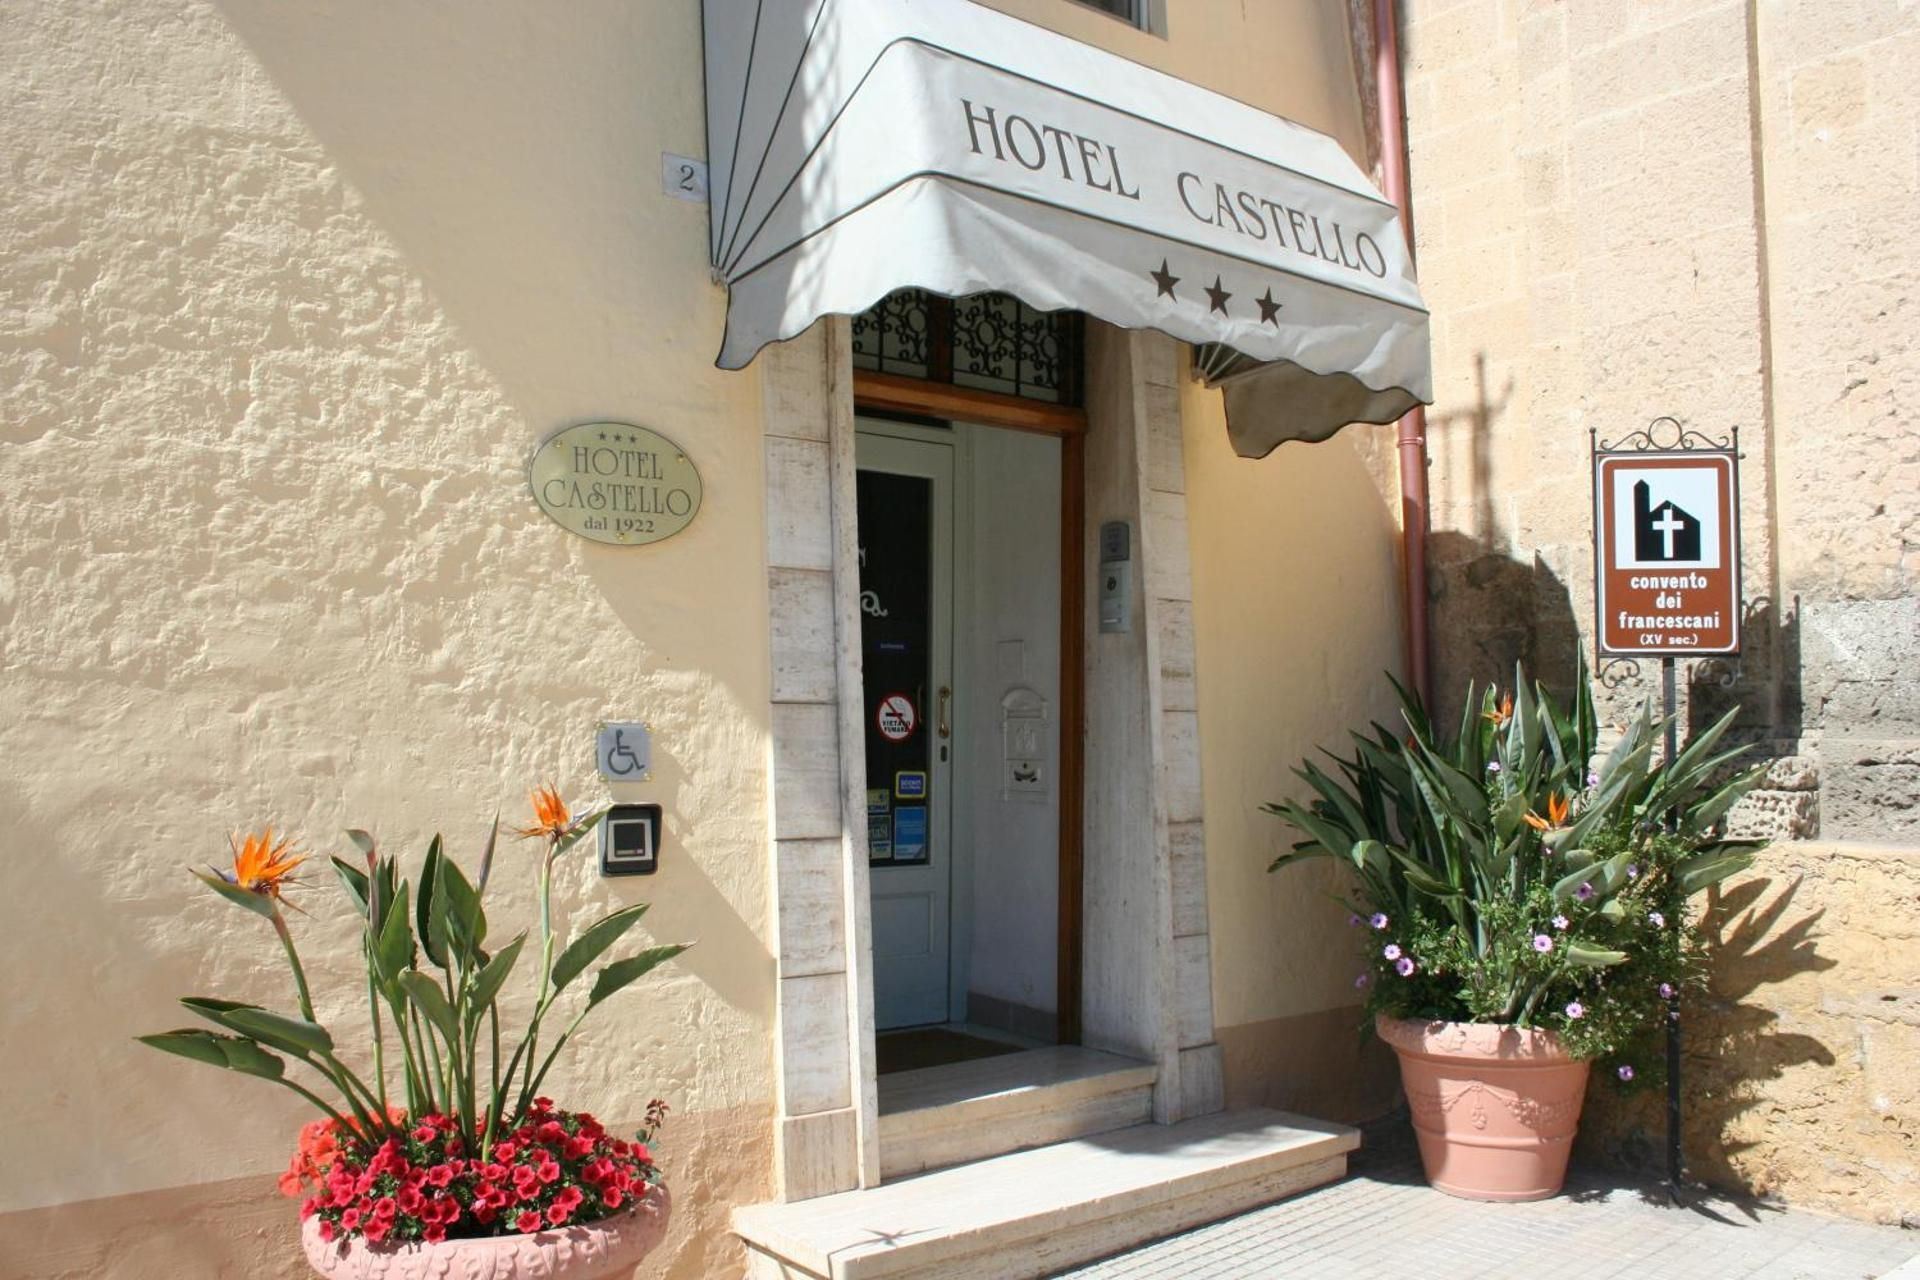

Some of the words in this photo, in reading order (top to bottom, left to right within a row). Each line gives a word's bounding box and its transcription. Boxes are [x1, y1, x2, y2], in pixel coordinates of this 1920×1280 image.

[680, 164, 695, 192] 2
[961, 98, 1141, 201] HOTEL
[1177, 171, 1388, 279] CASTELLO
[573, 446, 664, 481] HOTEL
[543, 479, 692, 517] CASTELLO
[584, 516, 608, 531] dal
[615, 518, 655, 533] 1922
[1630, 572, 1708, 589] convento
[1655, 591, 1682, 609] dei
[1618, 611, 1720, 629] francescani
[1639, 633, 1663, 646] (XV
[1668, 633, 1699, 646] sec.)
